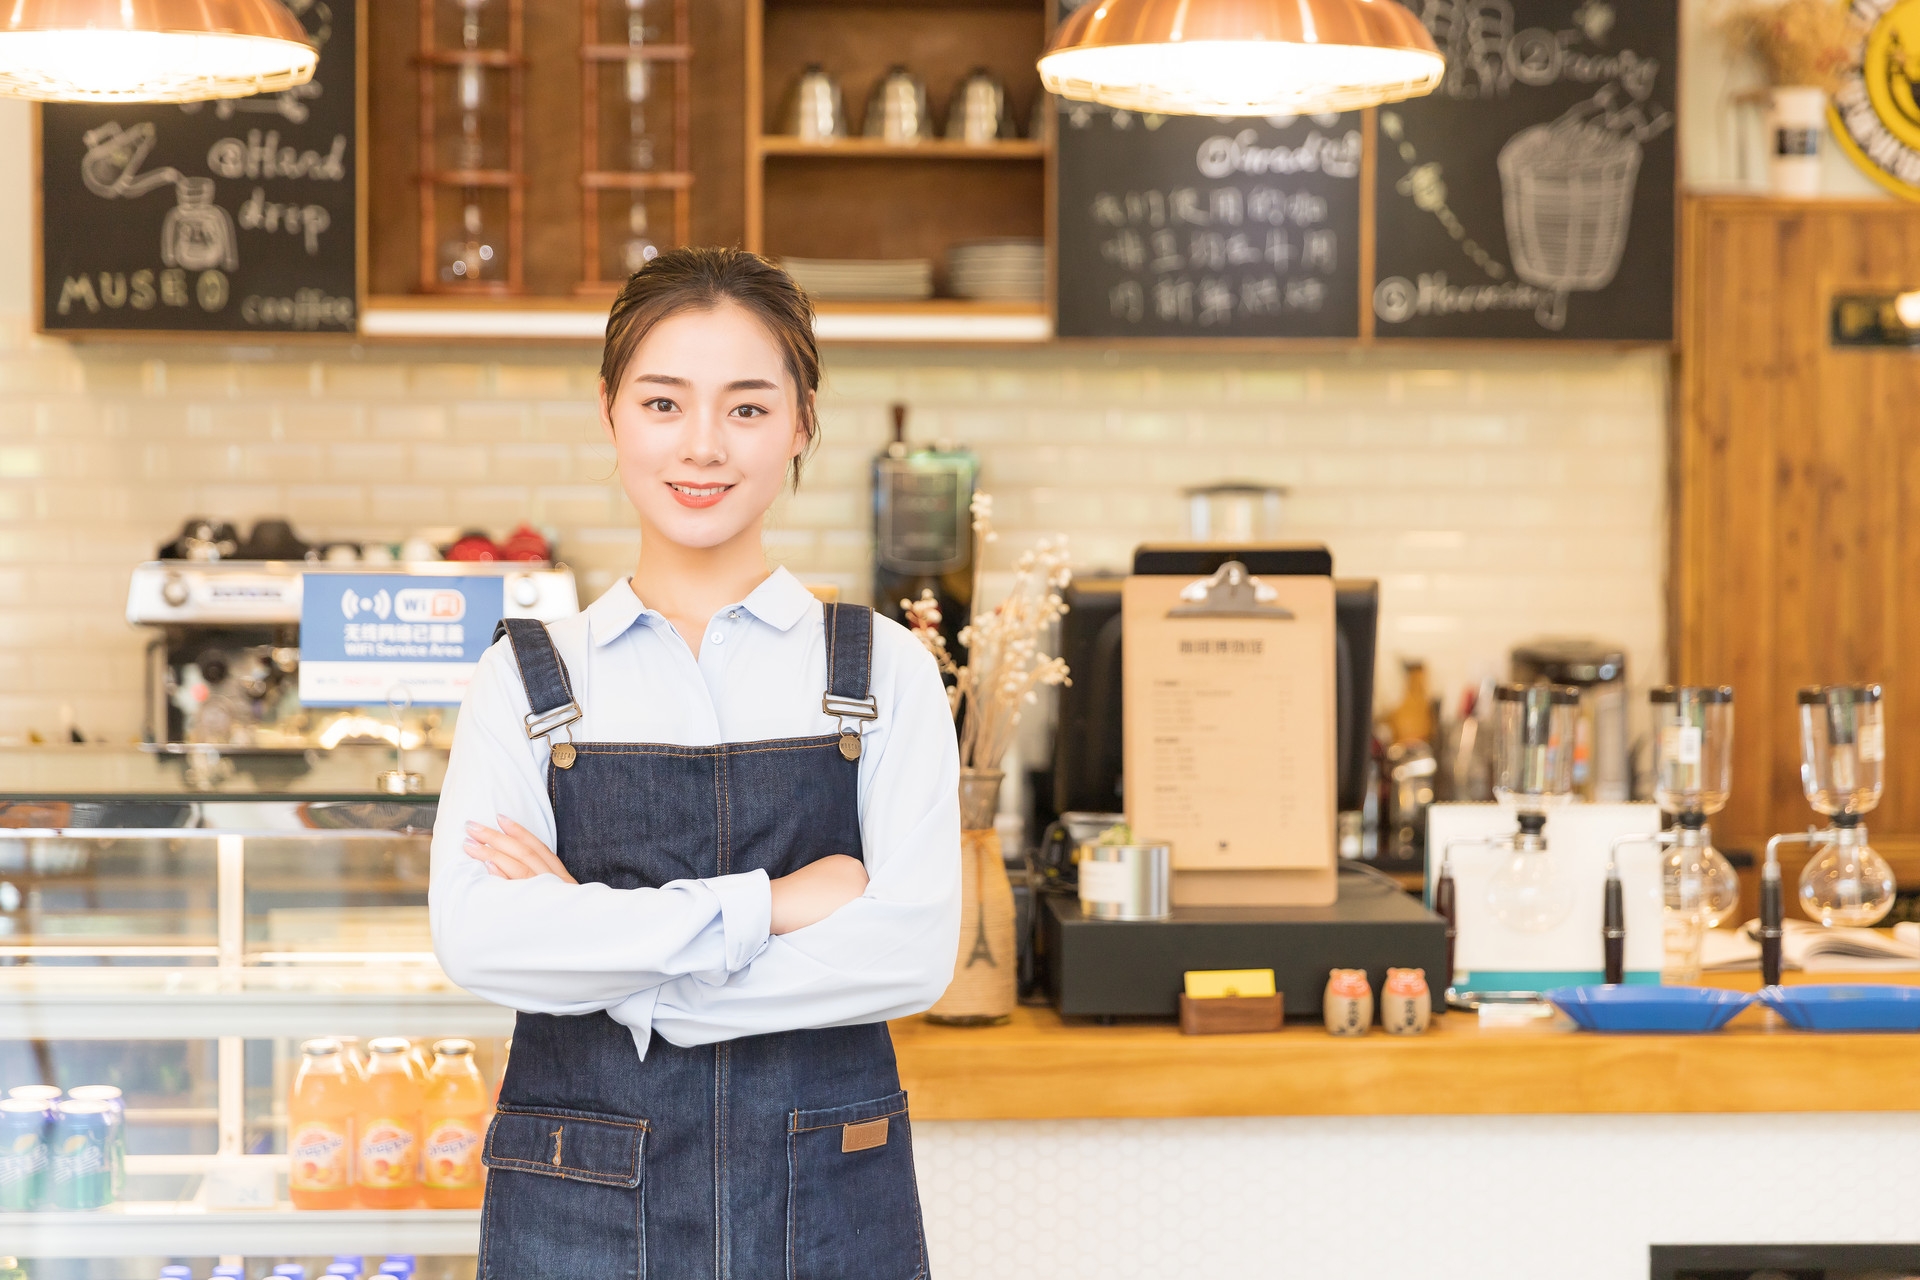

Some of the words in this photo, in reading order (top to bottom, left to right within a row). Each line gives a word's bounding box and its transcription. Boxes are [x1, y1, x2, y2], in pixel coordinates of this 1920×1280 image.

[238, 187, 331, 254] drip
[56, 268, 229, 315] MUSEO
[376, 642, 428, 657] Service
[429, 643, 465, 657] Area
